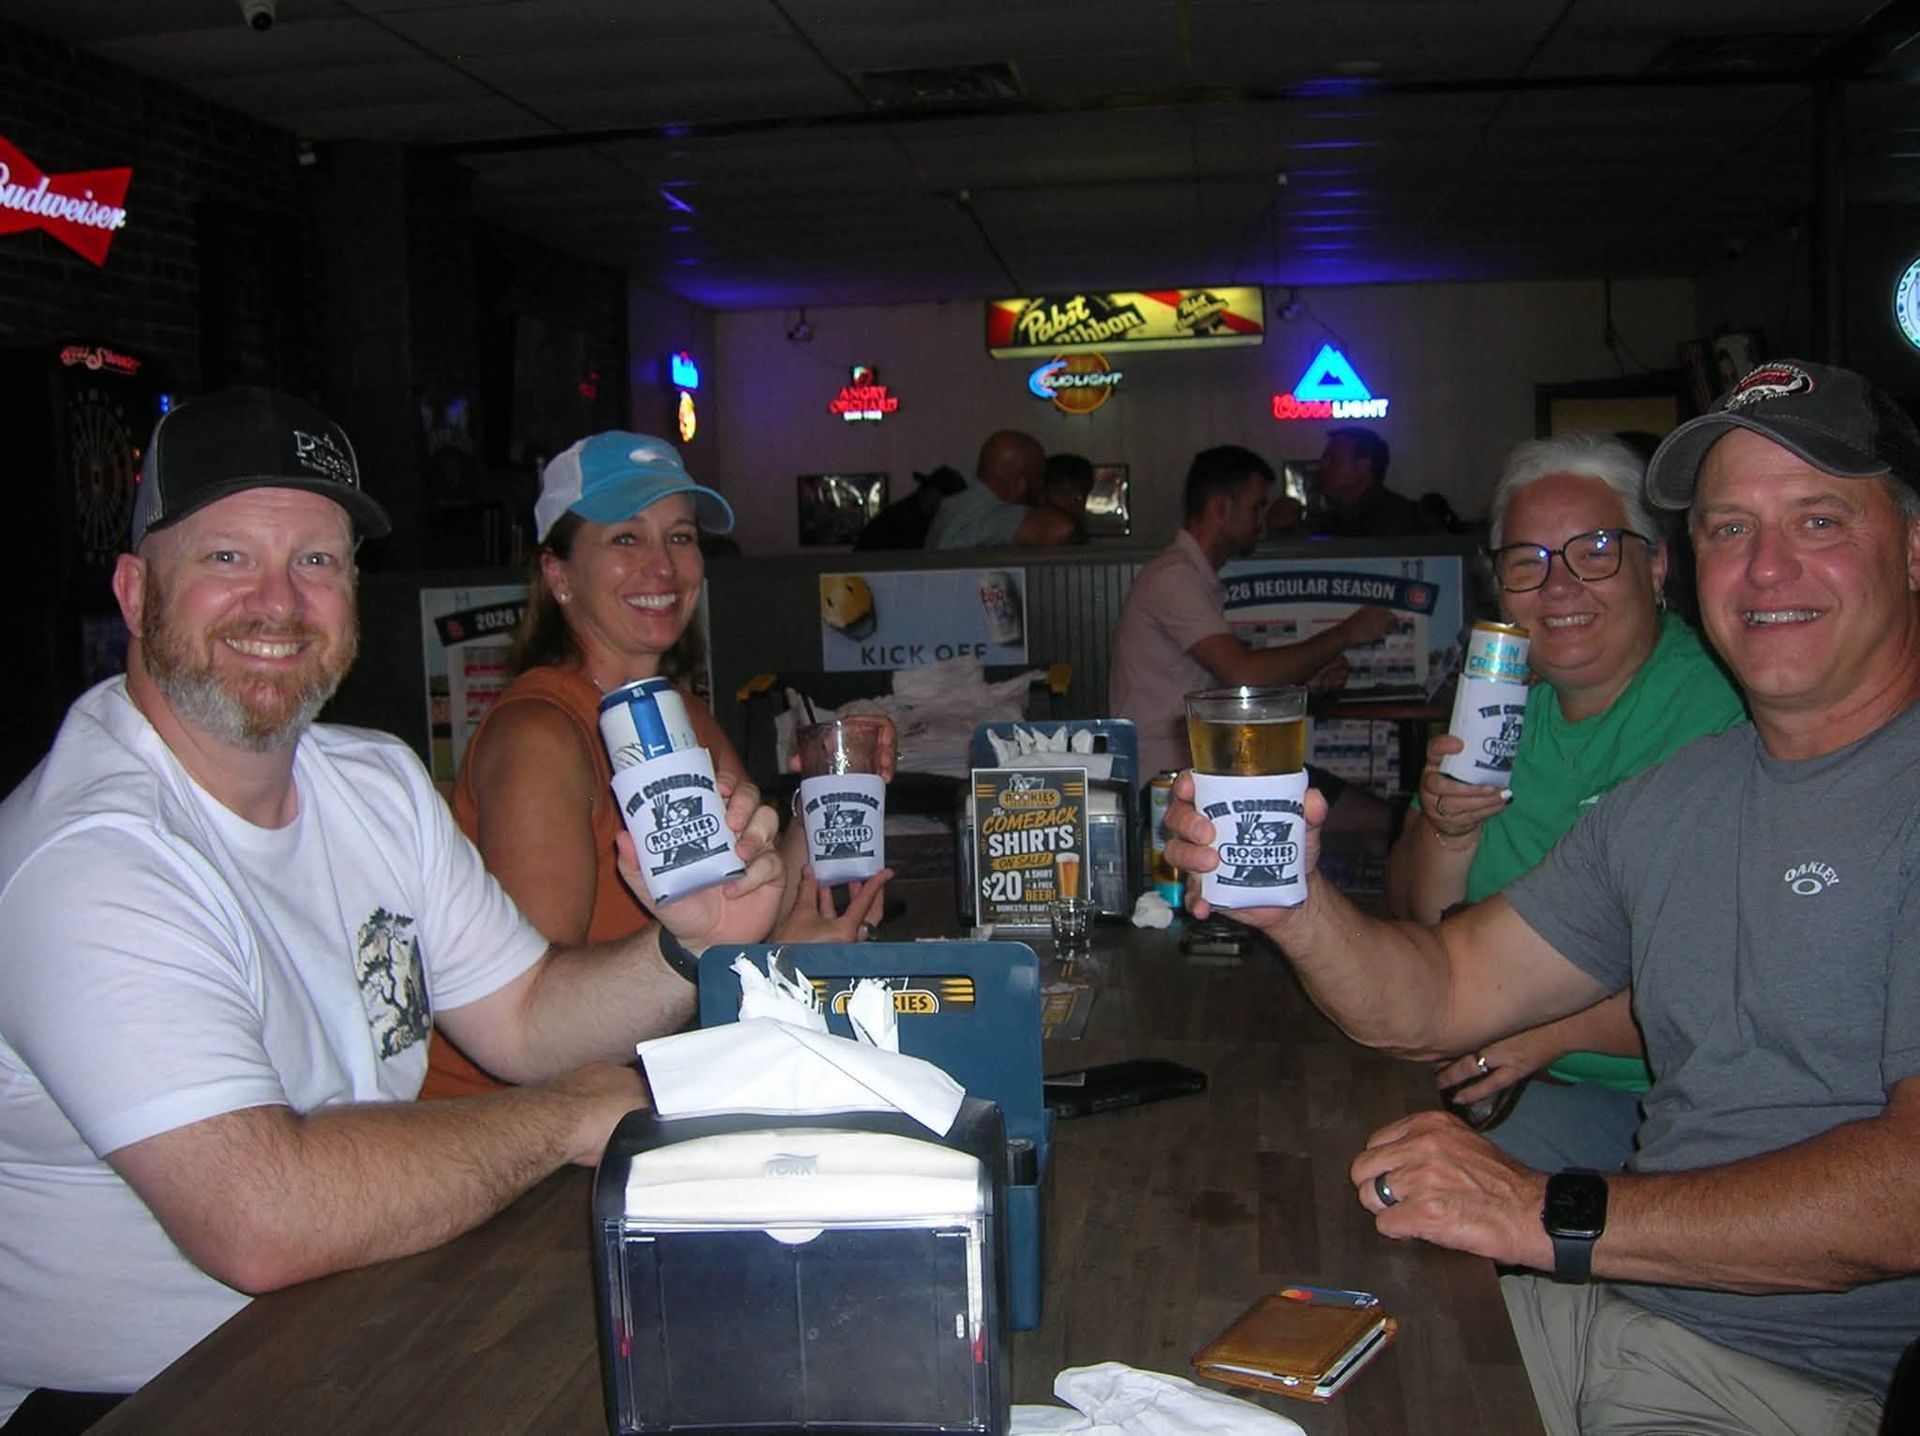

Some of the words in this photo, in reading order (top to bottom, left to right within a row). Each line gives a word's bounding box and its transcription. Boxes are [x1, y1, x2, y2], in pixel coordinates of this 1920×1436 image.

[1019, 295, 1090, 345] Pabst
[1076, 372, 1123, 387] LIGHT
[1332, 399, 1389, 419] LIGHT
[1253, 579, 1328, 599] REGULAR
[1331, 578, 1396, 601] SEASON
[474, 607, 517, 632] 2026
[861, 645, 925, 665] KICK
[642, 773, 715, 800] COMEBACK
[1005, 791, 1057, 802] ROOKIES
[651, 817, 713, 847] ROOKIES
[982, 806, 1078, 834] COMEBACK
[988, 824, 1075, 857] SHIRTS
[1226, 845, 1293, 859] ROOKIES
[982, 870, 1022, 902] $20
[1784, 861, 1840, 888] OAKLEY
